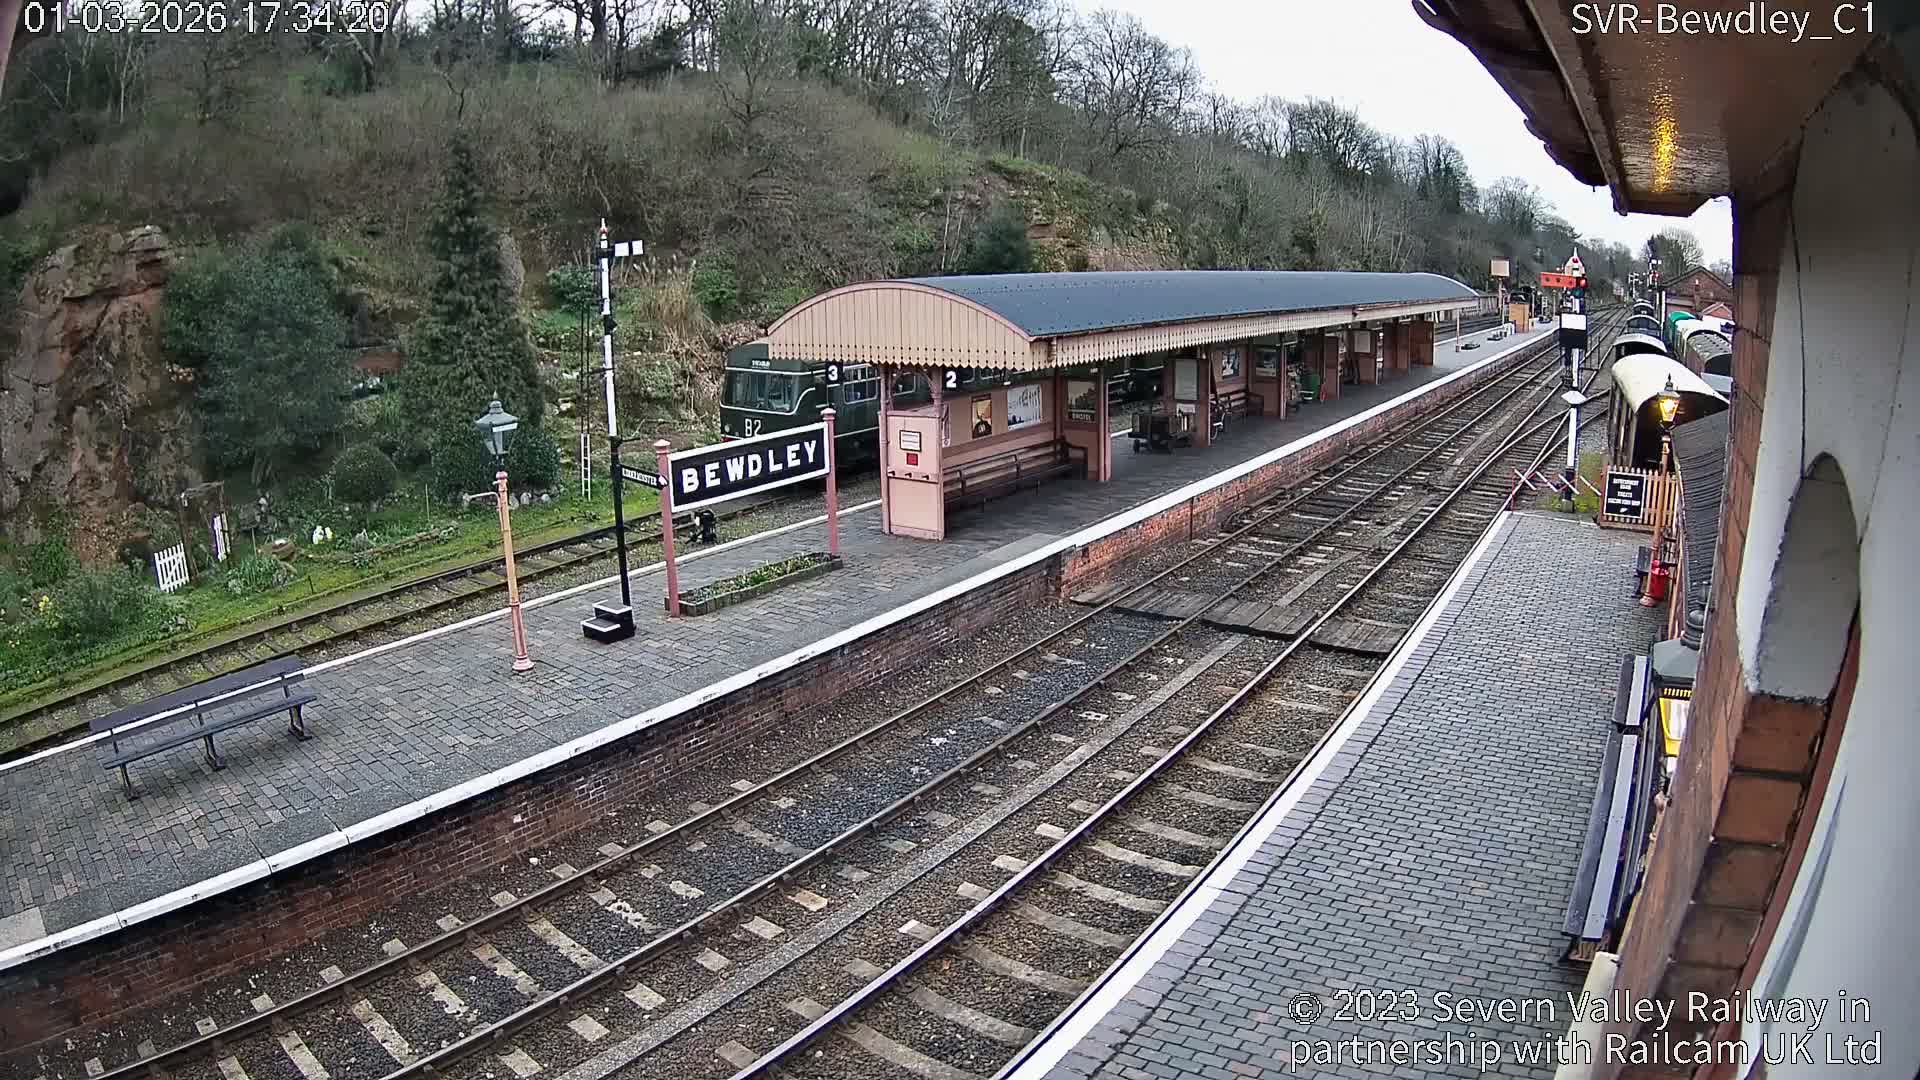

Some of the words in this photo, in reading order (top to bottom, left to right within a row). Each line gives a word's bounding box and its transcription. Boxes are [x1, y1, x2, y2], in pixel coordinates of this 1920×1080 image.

[827, 364, 839, 382] 3
[945, 370, 958, 389] 2
[681, 439, 818, 494] BEWDLEY
